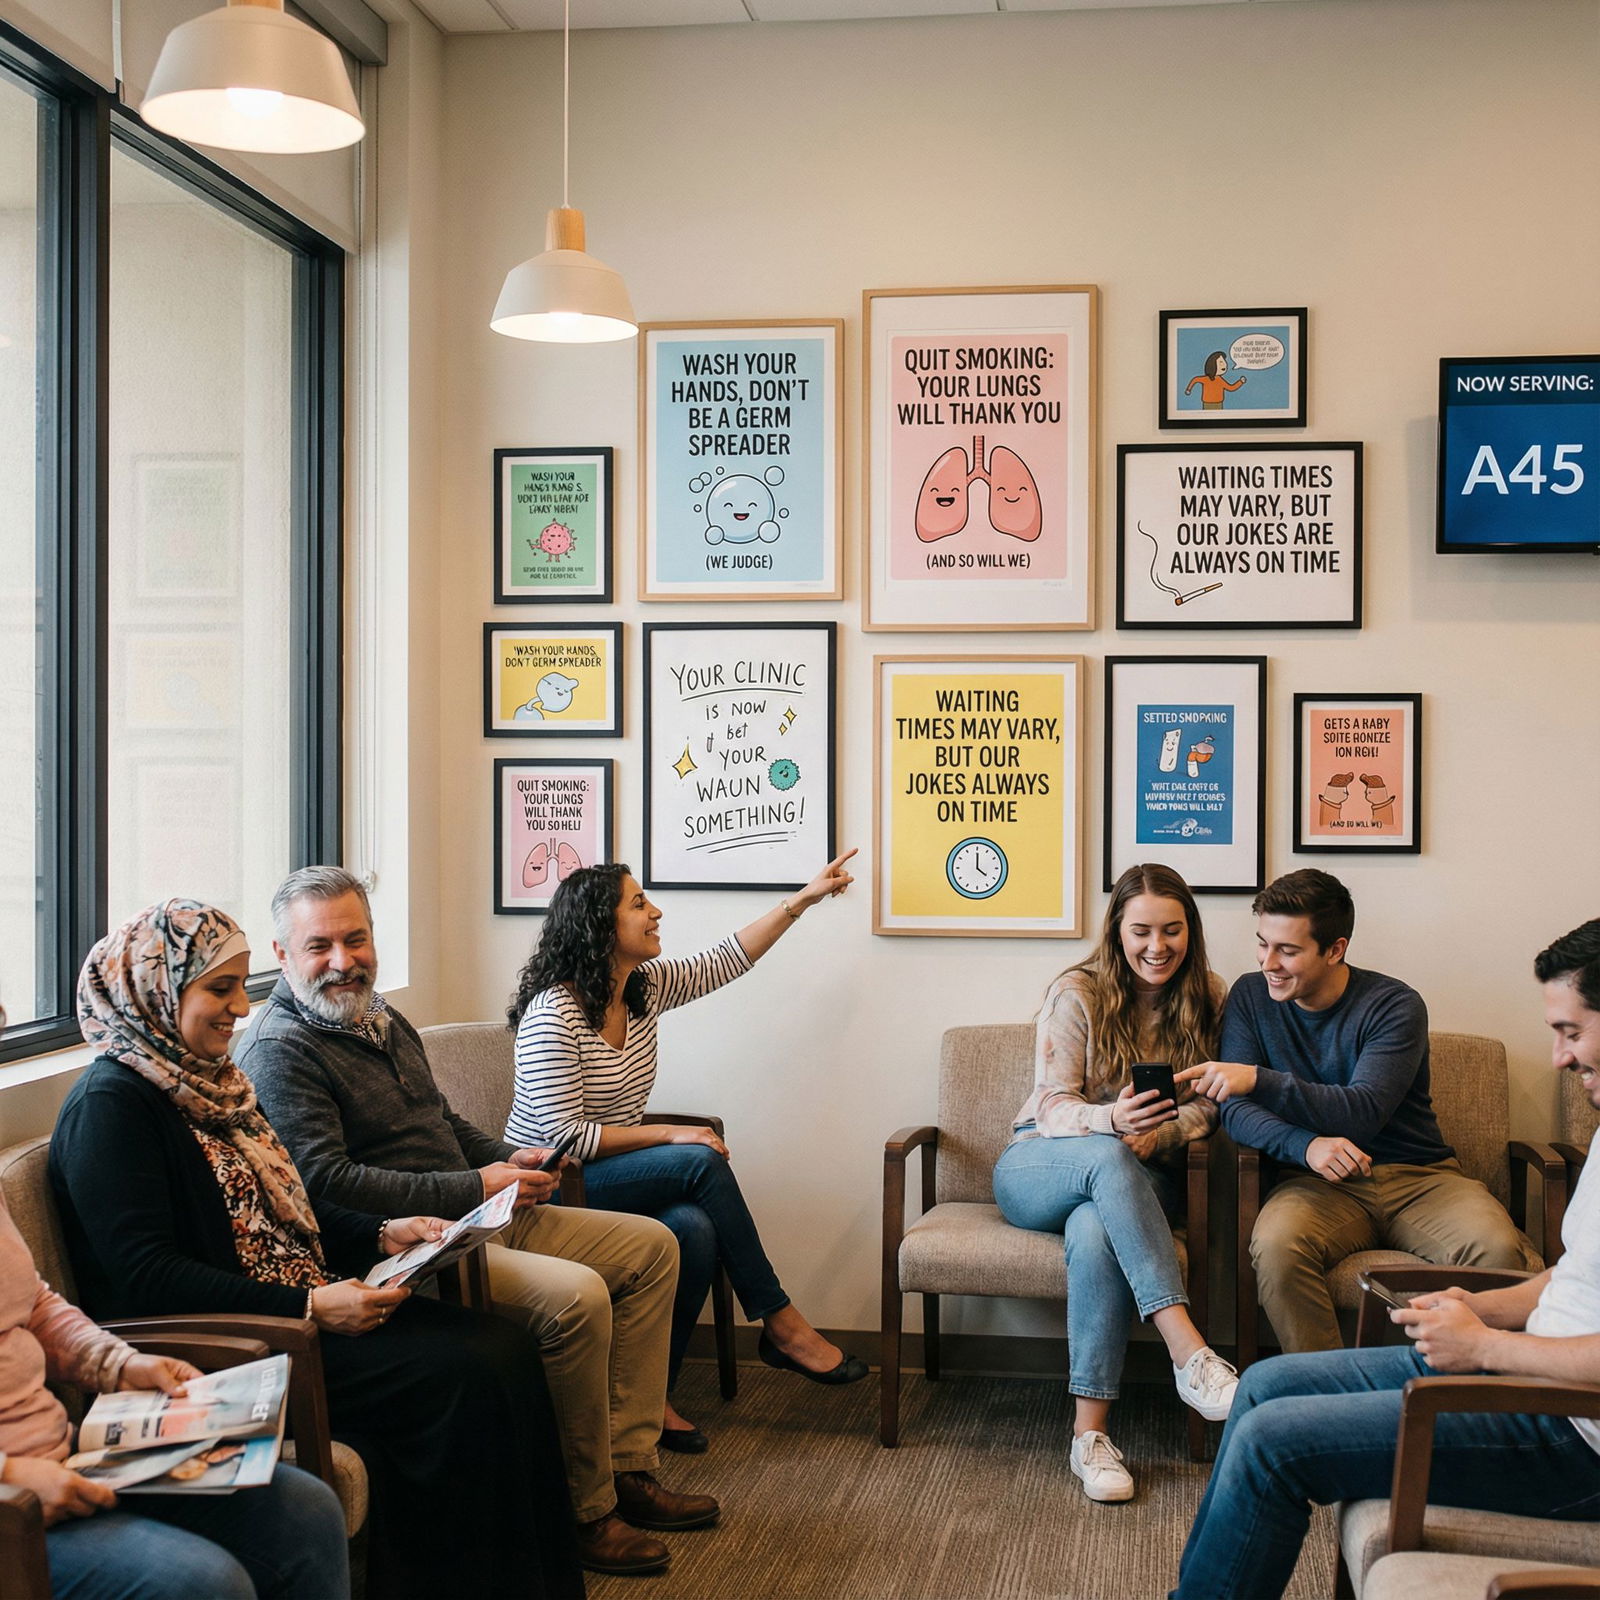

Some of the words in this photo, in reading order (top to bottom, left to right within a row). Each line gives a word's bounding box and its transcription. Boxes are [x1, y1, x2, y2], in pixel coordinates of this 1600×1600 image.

[683, 354, 739, 376] WASH
[744, 353, 797, 375] YOUR
[905, 349, 950, 373] QUIT
[955, 347, 1055, 370] SMOKING:
[671, 381, 743, 405] HANDS,
[750, 379, 809, 401] DON'T
[917, 376, 970, 398] YOUR
[976, 374, 1041, 397] LUNGS
[1457, 376, 1505, 392] NOW
[1509, 375, 1594, 391] SERVING:
[688, 408, 712, 429] BE
[717, 408, 730, 428] A
[736, 407, 791, 428] GERM
[897, 403, 944, 425] WILL
[949, 402, 1016, 424] THANK
[1022, 401, 1061, 424] YOU
[688, 434, 791, 456] SPREADER
[1179, 465, 1265, 489] WAITING
[1270, 465, 1333, 489] TIMES
[1461, 444, 1585, 495] A45
[1180, 495, 1223, 518] MAY
[1228, 494, 1285, 520] VARY,
[1291, 494, 1331, 517] BUT
[1177, 523, 1219, 546] OUR
[1225, 522, 1288, 546] JOKES
[1294, 522, 1333, 545] ARE
[706, 554, 729, 571] (WE
[732, 554, 773, 571] JUDGE)
[926, 554, 956, 569] (AND
[958, 554, 974, 568] SO
[977, 553, 1005, 567] WILL
[1008, 552, 1031, 569] WE)
[1170, 551, 1250, 574] ALWAYS
[1256, 551, 1285, 574] ON
[1291, 550, 1340, 573] TIME
[542, 645, 563, 655] YOUR
[533, 658, 556, 667] GERM
[670, 663, 725, 694] YOUR
[734, 661, 807, 687] CLINIC
[731, 700, 767, 716] NOW
[936, 690, 1019, 712] WAITING
[896, 718, 955, 740] TIMES
[961, 718, 1002, 740] MAY
[1006, 718, 1060, 744] VARY,
[1324, 718, 1351, 729] GETS
[1353, 718, 1360, 729] A
[719, 746, 767, 771] YOUR
[935, 746, 973, 767] BUT
[979, 746, 1020, 767] OUR
[517, 780, 539, 792] QUIT
[542, 780, 590, 791] SMOKING:
[696, 774, 761, 803] WAUN
[906, 773, 966, 795] JOKES
[972, 773, 1050, 795] ALWAYS
[524, 794, 549, 804] YOUR
[552, 794, 583, 804] LUNGS
[524, 807, 547, 818] WILL
[550, 807, 582, 818] THANK
[684, 796, 805, 838] SOMETHING!
[937, 801, 965, 823] ON
[971, 801, 1018, 822] TIME
[526, 820, 545, 830] YOU
[548, 820, 560, 830] SO
